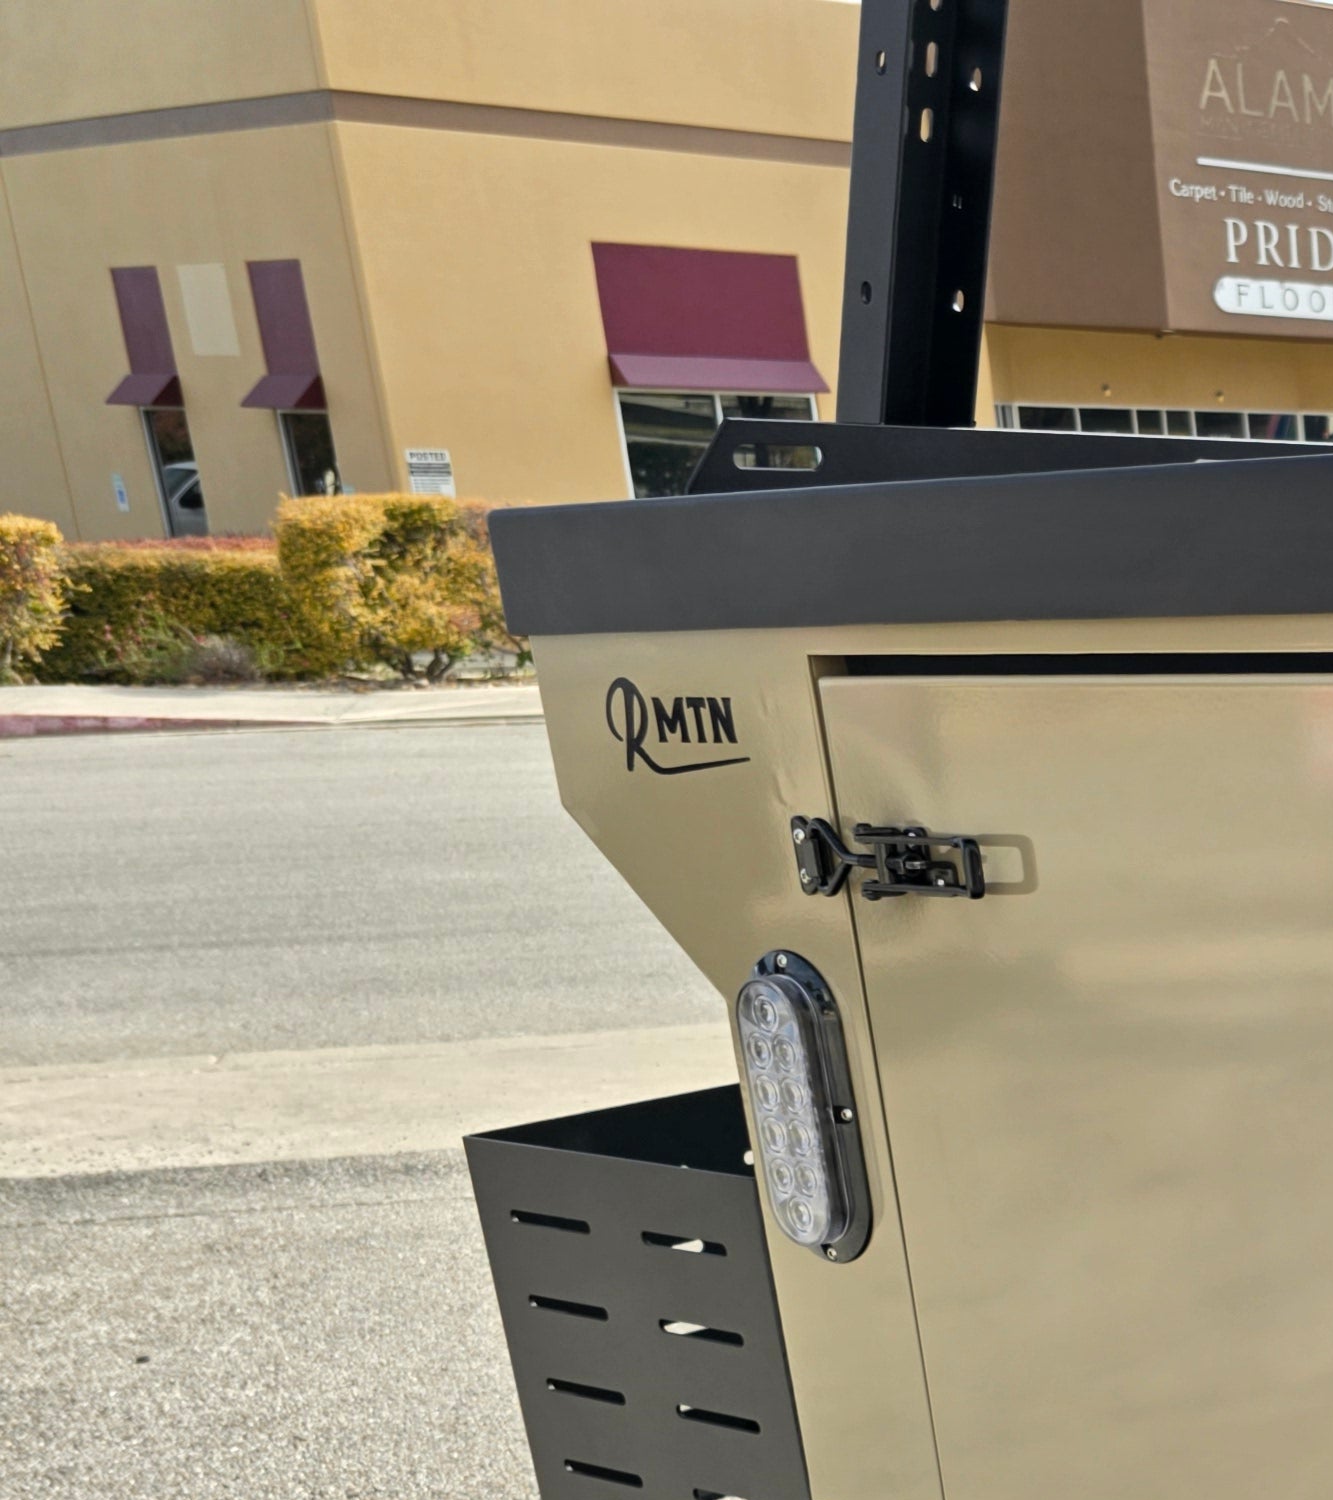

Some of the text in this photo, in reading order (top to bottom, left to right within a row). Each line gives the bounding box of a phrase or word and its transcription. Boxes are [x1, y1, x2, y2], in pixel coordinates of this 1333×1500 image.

[1169, 178, 1217, 202] Carpet
[1229, 185, 1254, 205] Tile
[1264, 190, 1304, 209] Wood
